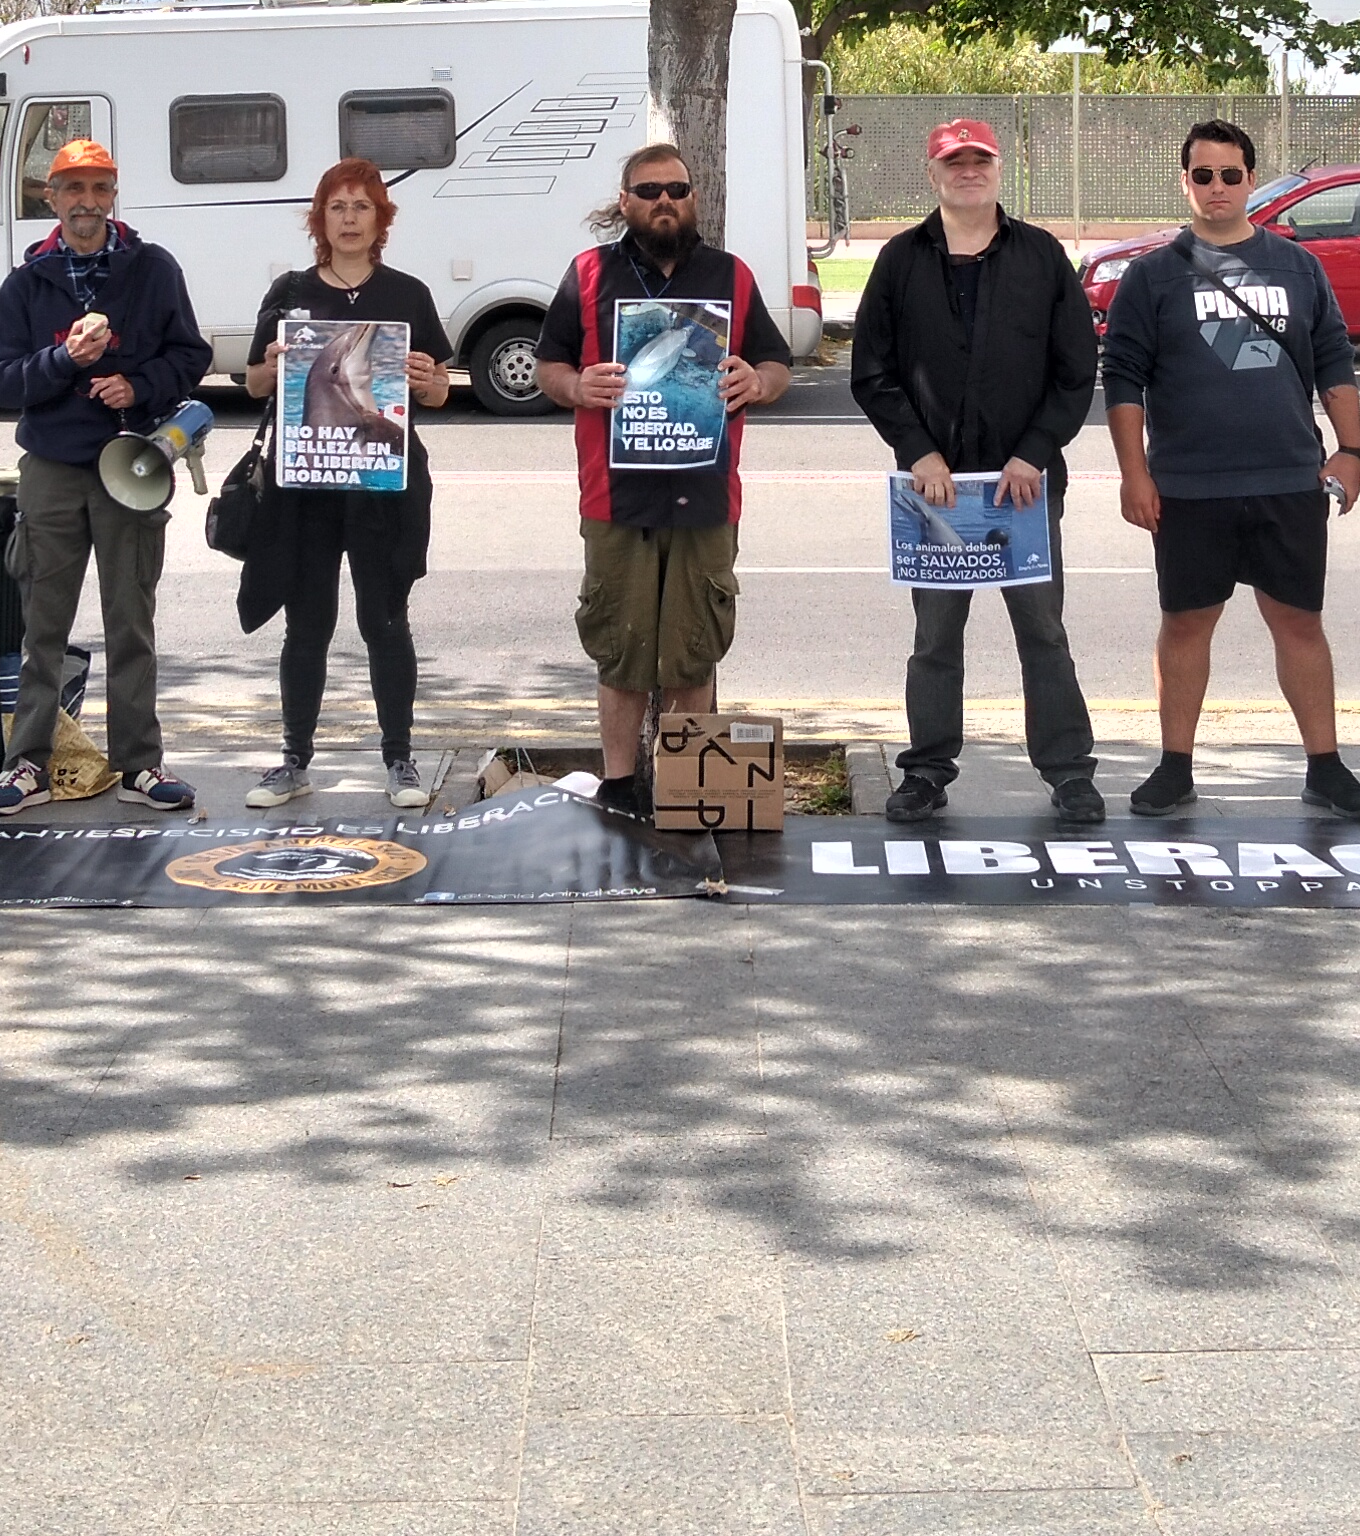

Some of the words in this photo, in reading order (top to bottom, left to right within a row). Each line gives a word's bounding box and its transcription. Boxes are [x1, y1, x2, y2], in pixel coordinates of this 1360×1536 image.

[1193, 285, 1290, 321] PUMA
[622, 390, 663, 404] ESTO
[622, 406, 647, 420] NO
[648, 406, 668, 420] ES
[284, 425, 314, 439] NO
[318, 426, 358, 440] HAY
[621, 421, 699, 438] LIBERTAD,
[284, 440, 362, 455] BELLEZA
[366, 441, 392, 456] EN
[621, 436, 634, 450] Y
[634, 436, 653, 451] EL
[653, 437, 676, 451] LO
[676, 436, 714, 451] SABE
[284, 454, 309, 468] LA
[313, 455, 401, 471] LIBERTAD
[284, 469, 362, 484] ROBADA
[895, 539, 913, 551] Los
[915, 541, 963, 553] animales
[965, 541, 1001, 552] deben
[896, 554, 916, 565] ser
[920, 553, 1006, 568] SALVADOS,
[897, 566, 918, 580] ¡NO
[920, 567, 1007, 581] ESCLAVIZADOS!
[338, 823, 384, 835] ES
